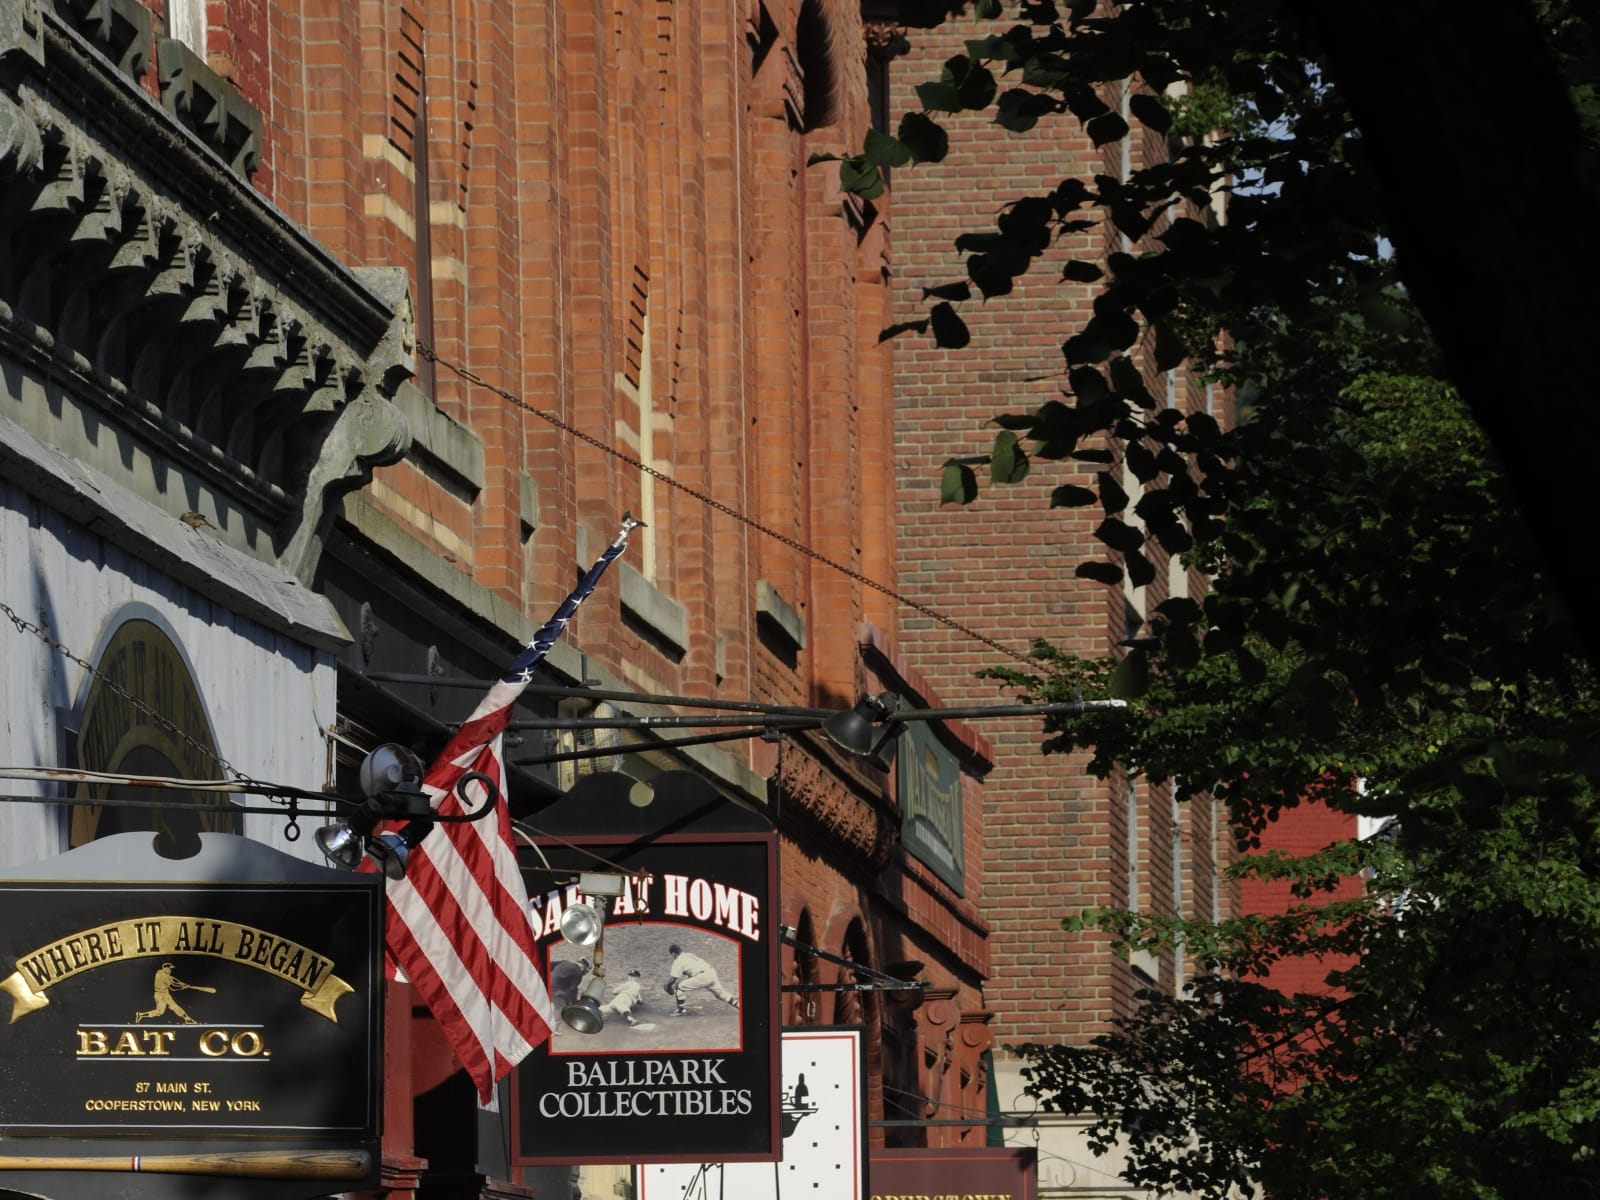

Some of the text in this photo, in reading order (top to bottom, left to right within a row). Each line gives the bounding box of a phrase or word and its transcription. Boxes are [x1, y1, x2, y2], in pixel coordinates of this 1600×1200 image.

[613, 873, 654, 916] AT
[663, 873, 760, 941] HOME
[23, 921, 328, 991] WHERE IT ALL BEGAN
[76, 1029, 272, 1057] BAT CO.
[135, 1082, 213, 1094] 87 MAIN ST.
[566, 1058, 727, 1088] BALLPARK
[85, 1100, 262, 1112] COOPERSTOWN, NEW YORK
[538, 1087, 753, 1119] COLLECTIBLES
